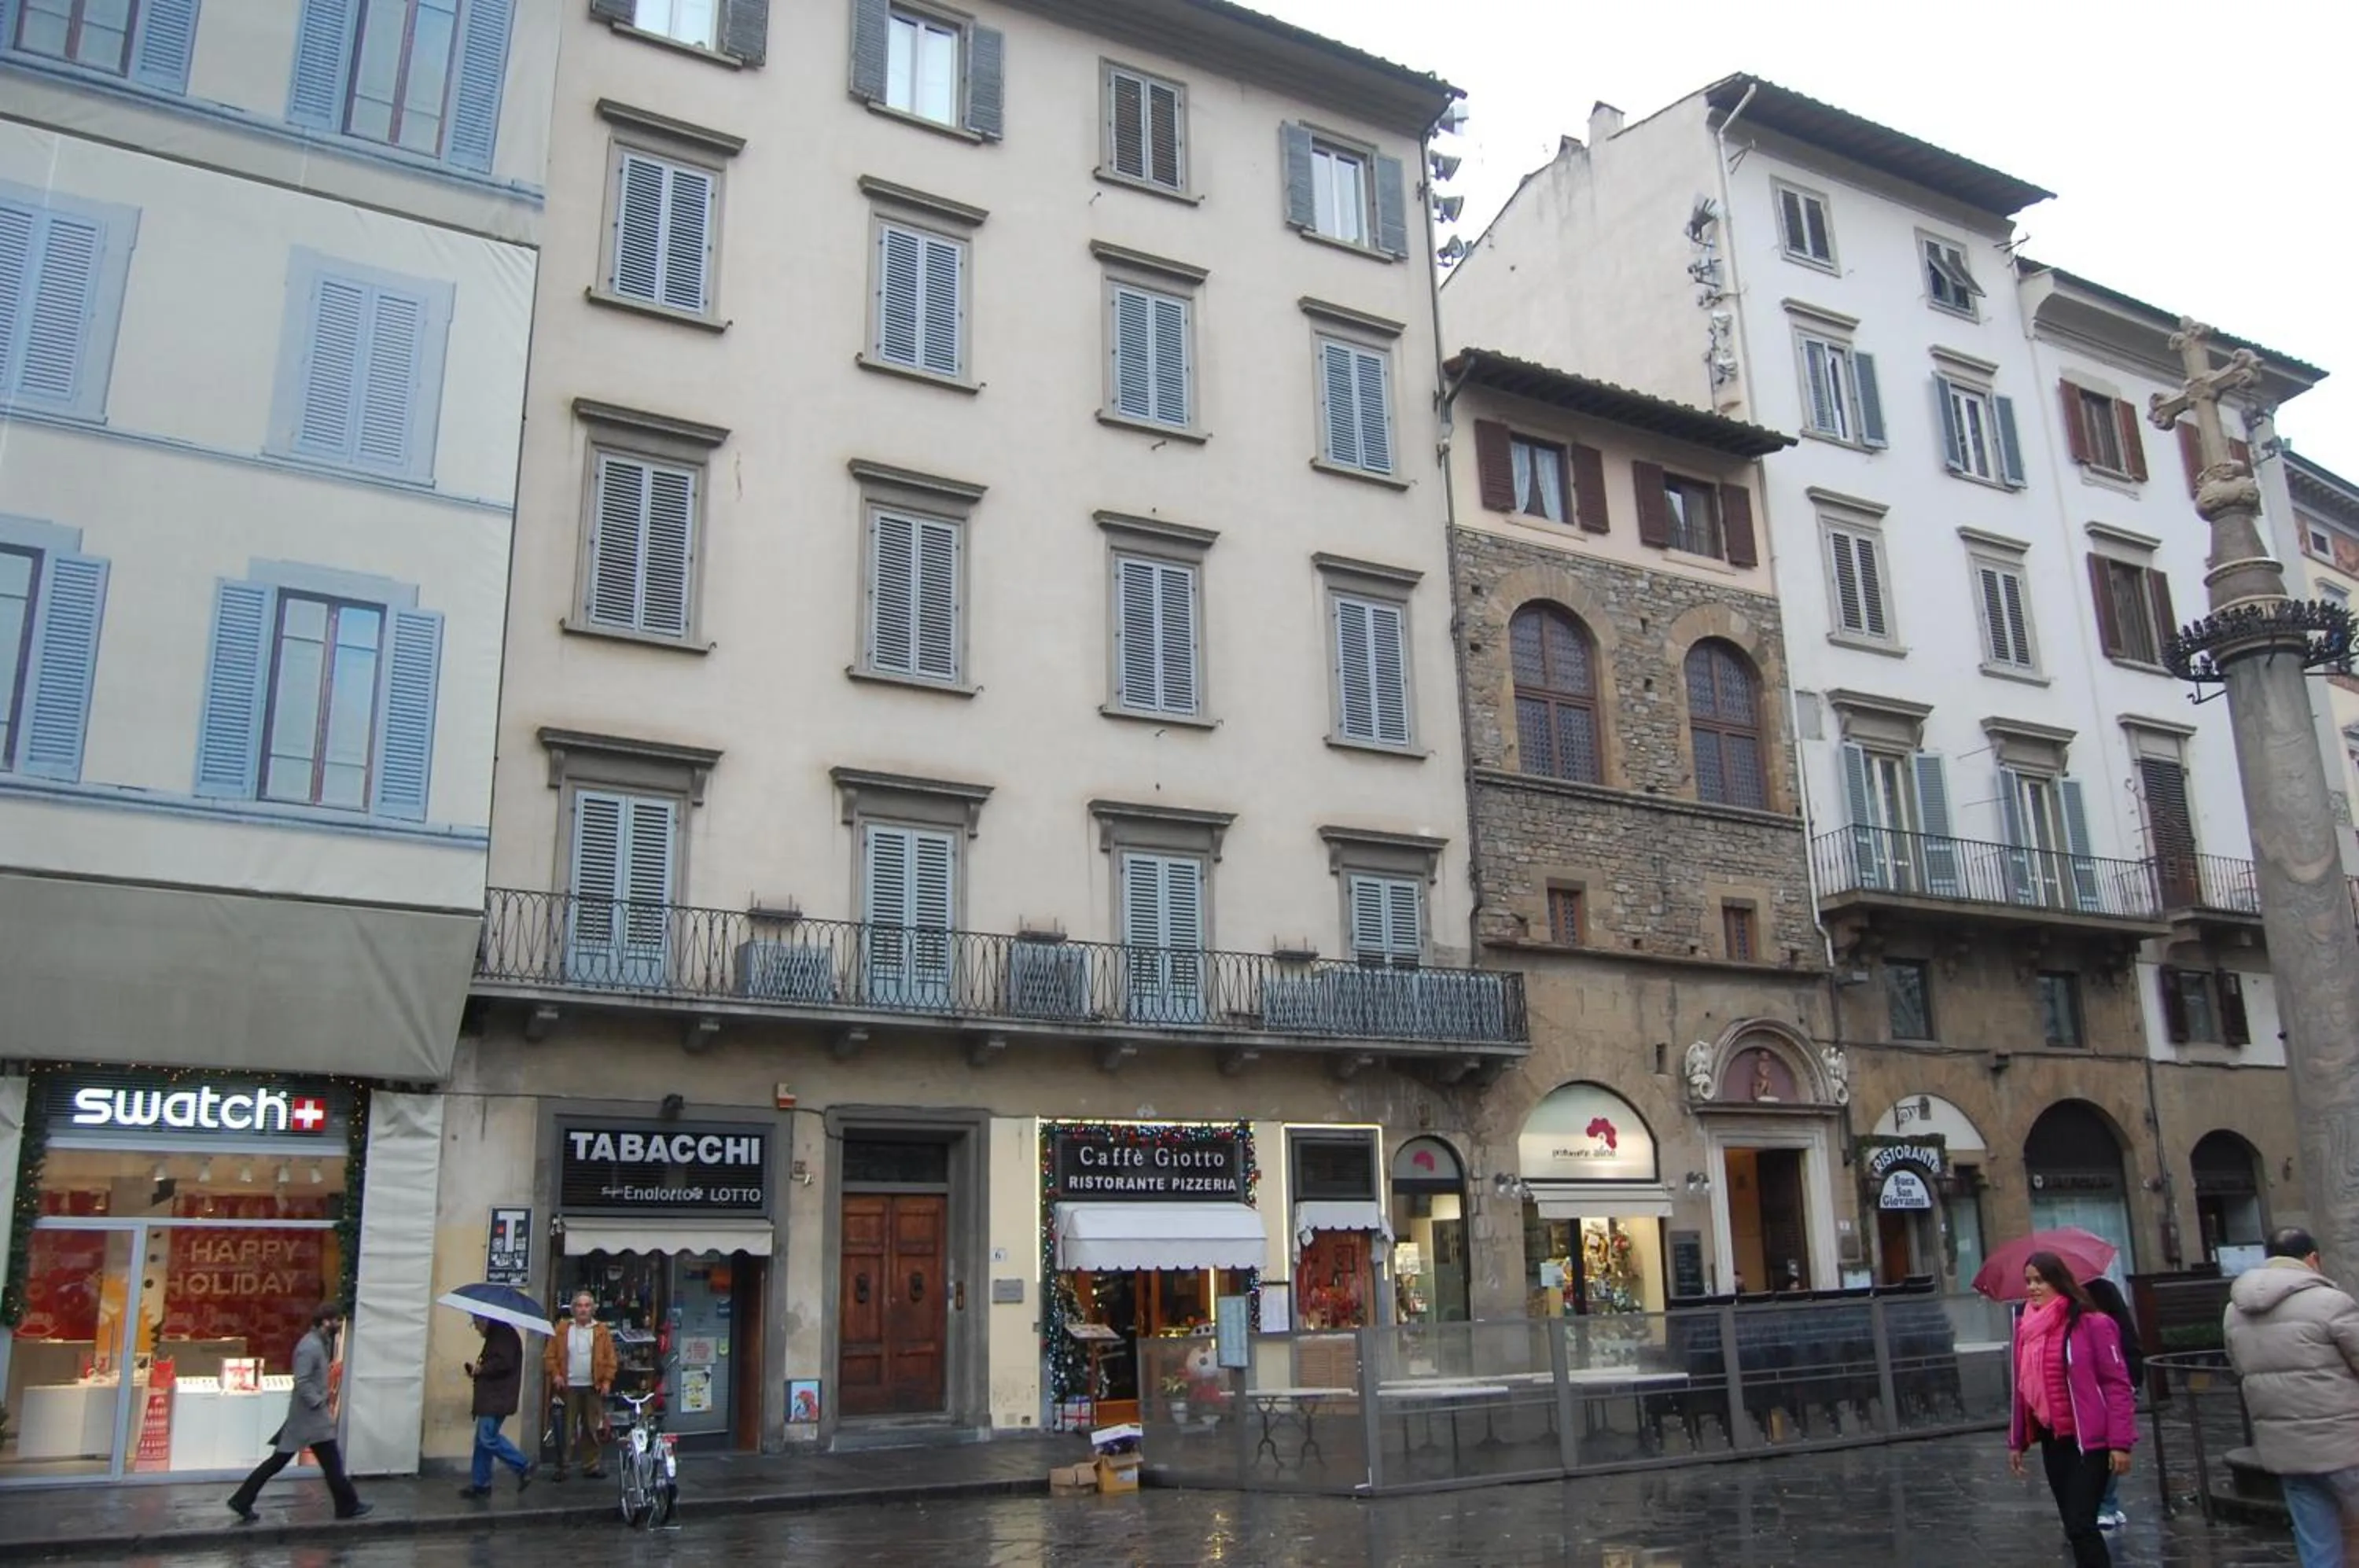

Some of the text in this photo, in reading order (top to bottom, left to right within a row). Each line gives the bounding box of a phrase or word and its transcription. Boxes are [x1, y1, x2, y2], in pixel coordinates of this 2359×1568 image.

[73, 1086, 287, 1130] swatch
[570, 1132, 760, 1165] TABACCHI
[1080, 1146, 1225, 1167] Caffè Giotto
[1874, 1144, 1941, 1173] RISTORANTE
[710, 1187, 761, 1202] LOTTO
[1069, 1176, 1238, 1191] RISTORANTE PIZZERIA
[1882, 1194, 1925, 1206] Giovanni
[190, 1239, 300, 1262] HAPPY
[167, 1272, 298, 1296] HOLIDAY
